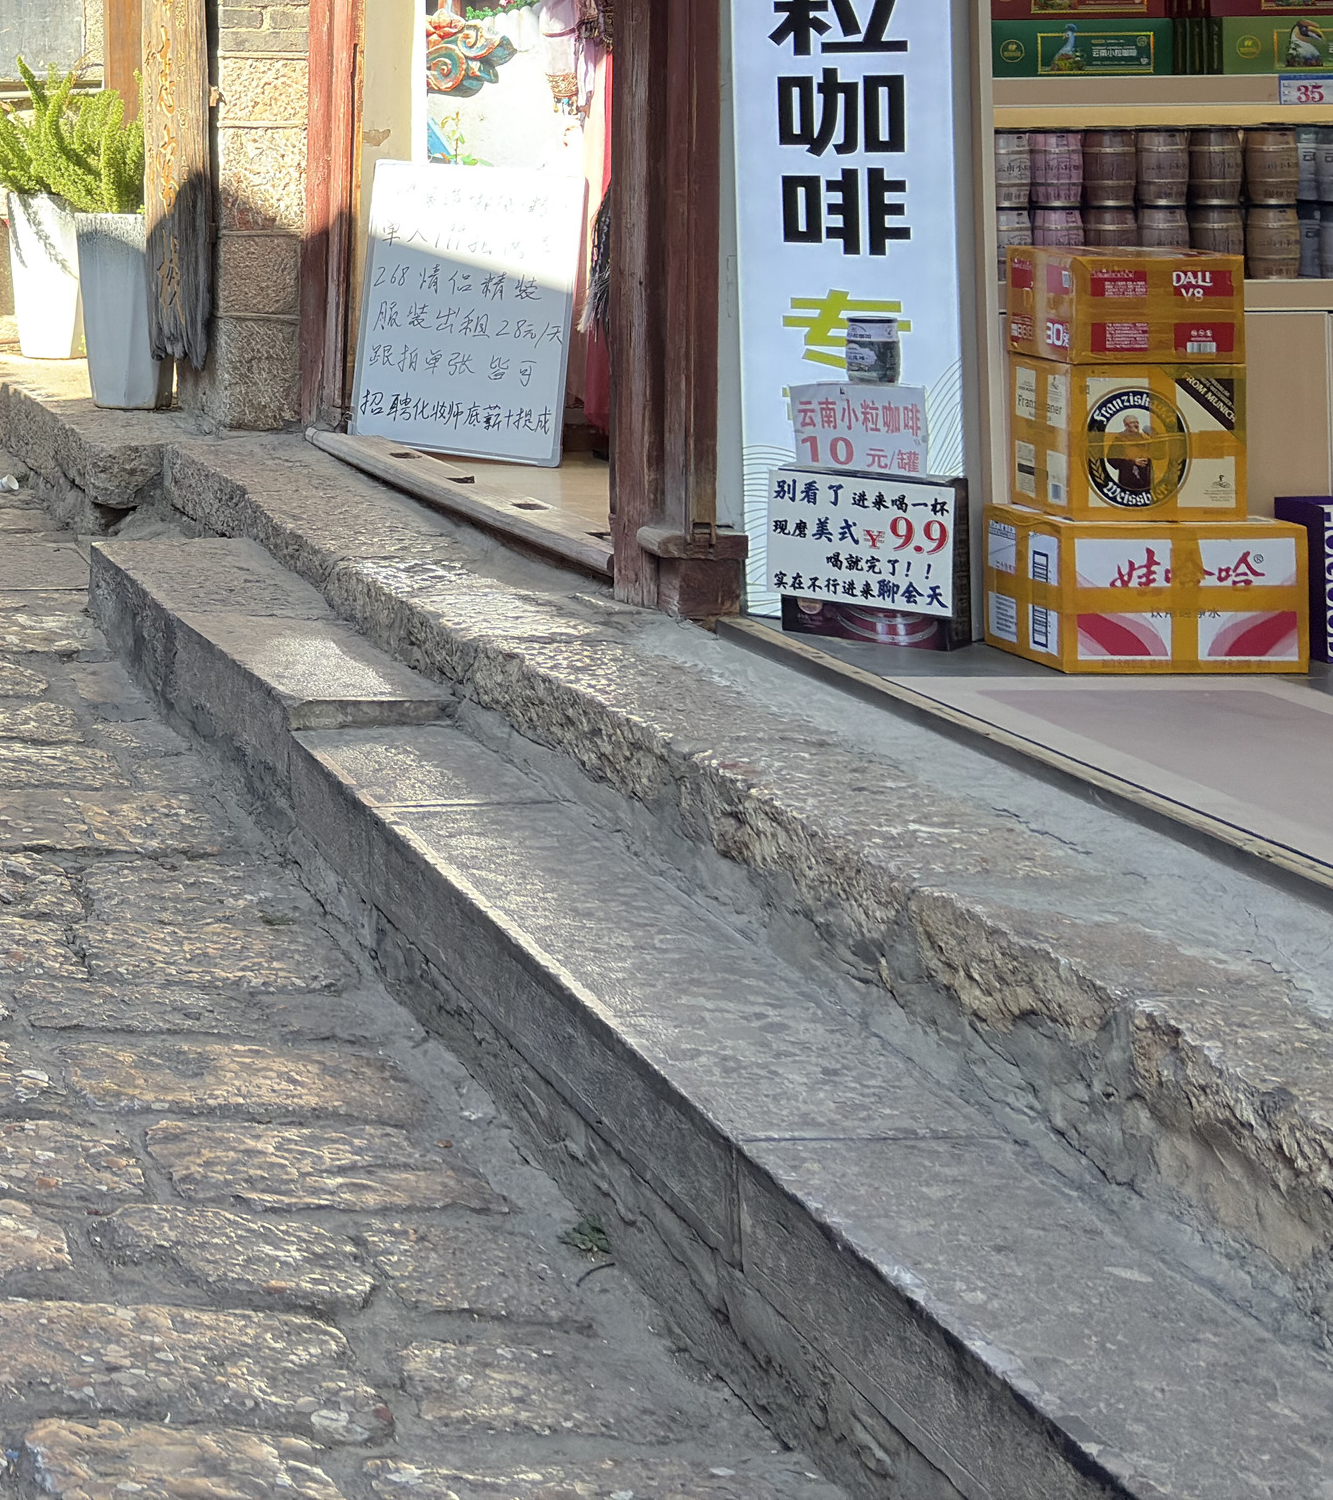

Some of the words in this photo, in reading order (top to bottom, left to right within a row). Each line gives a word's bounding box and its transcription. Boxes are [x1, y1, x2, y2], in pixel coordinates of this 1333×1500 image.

[1295, 84, 1325, 103] 35
[1172, 270, 1213, 287] DALI
[796, 396, 922, 438] 云南小粒咖啡
[800, 435, 855, 466] 10
[865, 448, 920, 474] 元/罐
[773, 478, 845, 507] 别看了
[851, 491, 951, 519] 进来喝一杯
[772, 517, 861, 546] 现磨美式
[773, 569, 949, 610] 实在不行进来聊会天
